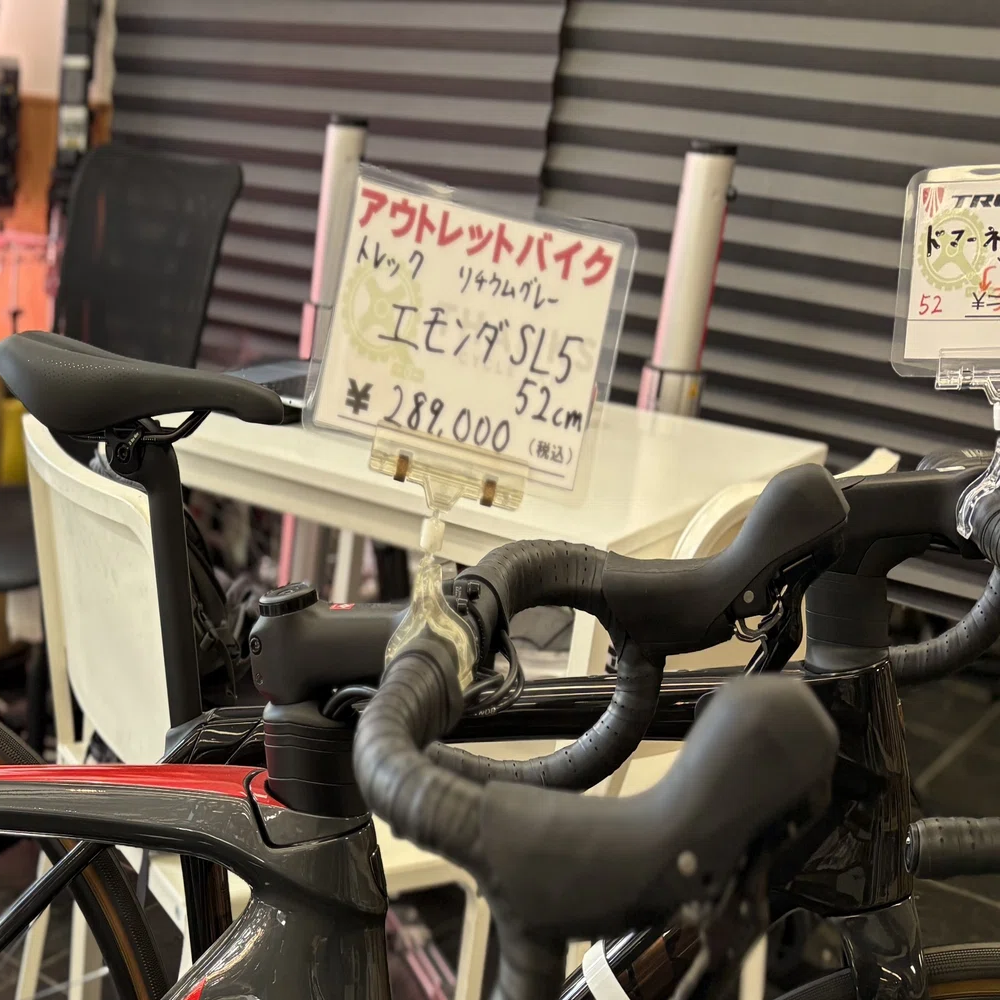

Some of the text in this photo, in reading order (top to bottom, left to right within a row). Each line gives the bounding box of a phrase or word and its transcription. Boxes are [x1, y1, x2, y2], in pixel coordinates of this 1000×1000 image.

[358, 187, 613, 286] アウトレットバイク
[357, 235, 559, 310] トレック リチウムグレー
[919, 293, 942, 315] 52
[515, 378, 582, 432] 52cm
